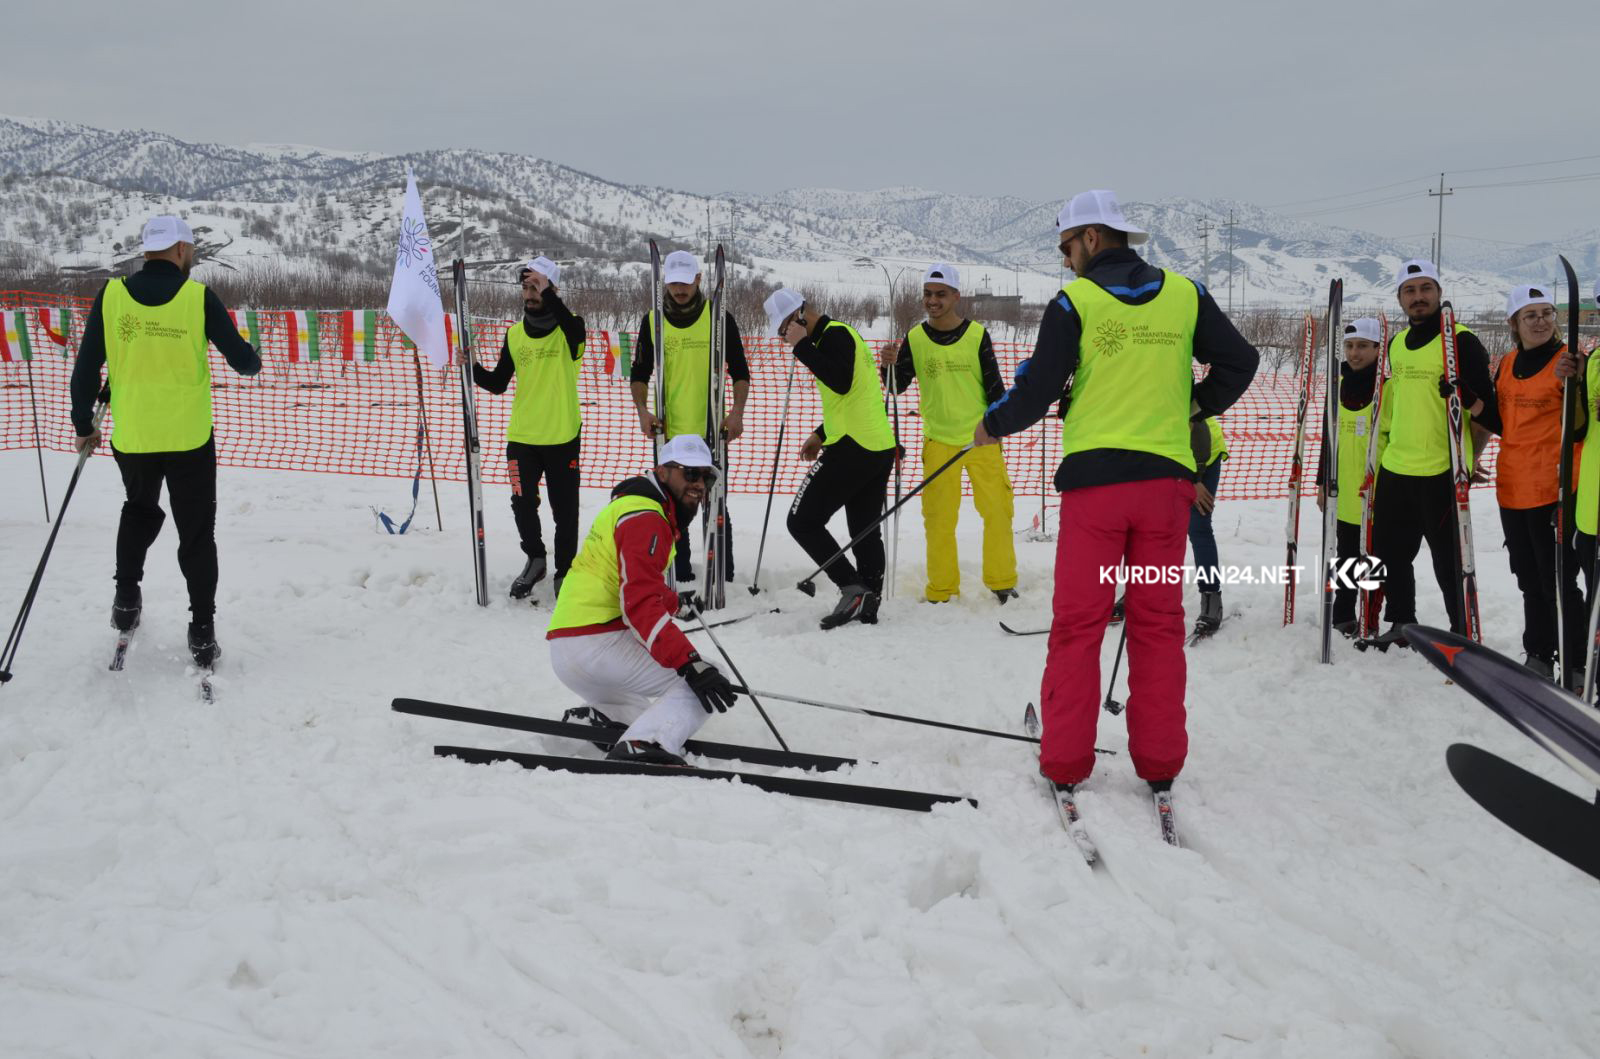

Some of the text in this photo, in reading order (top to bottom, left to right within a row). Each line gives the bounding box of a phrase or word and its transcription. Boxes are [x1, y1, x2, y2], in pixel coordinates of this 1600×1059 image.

[145, 326, 188, 335] HUMANITARIAN
[1132, 331, 1183, 340] HUMANITARIAN
[1132, 338, 1176, 346] FOUNDATION
[1302, 325, 1312, 381] ATOMIC
